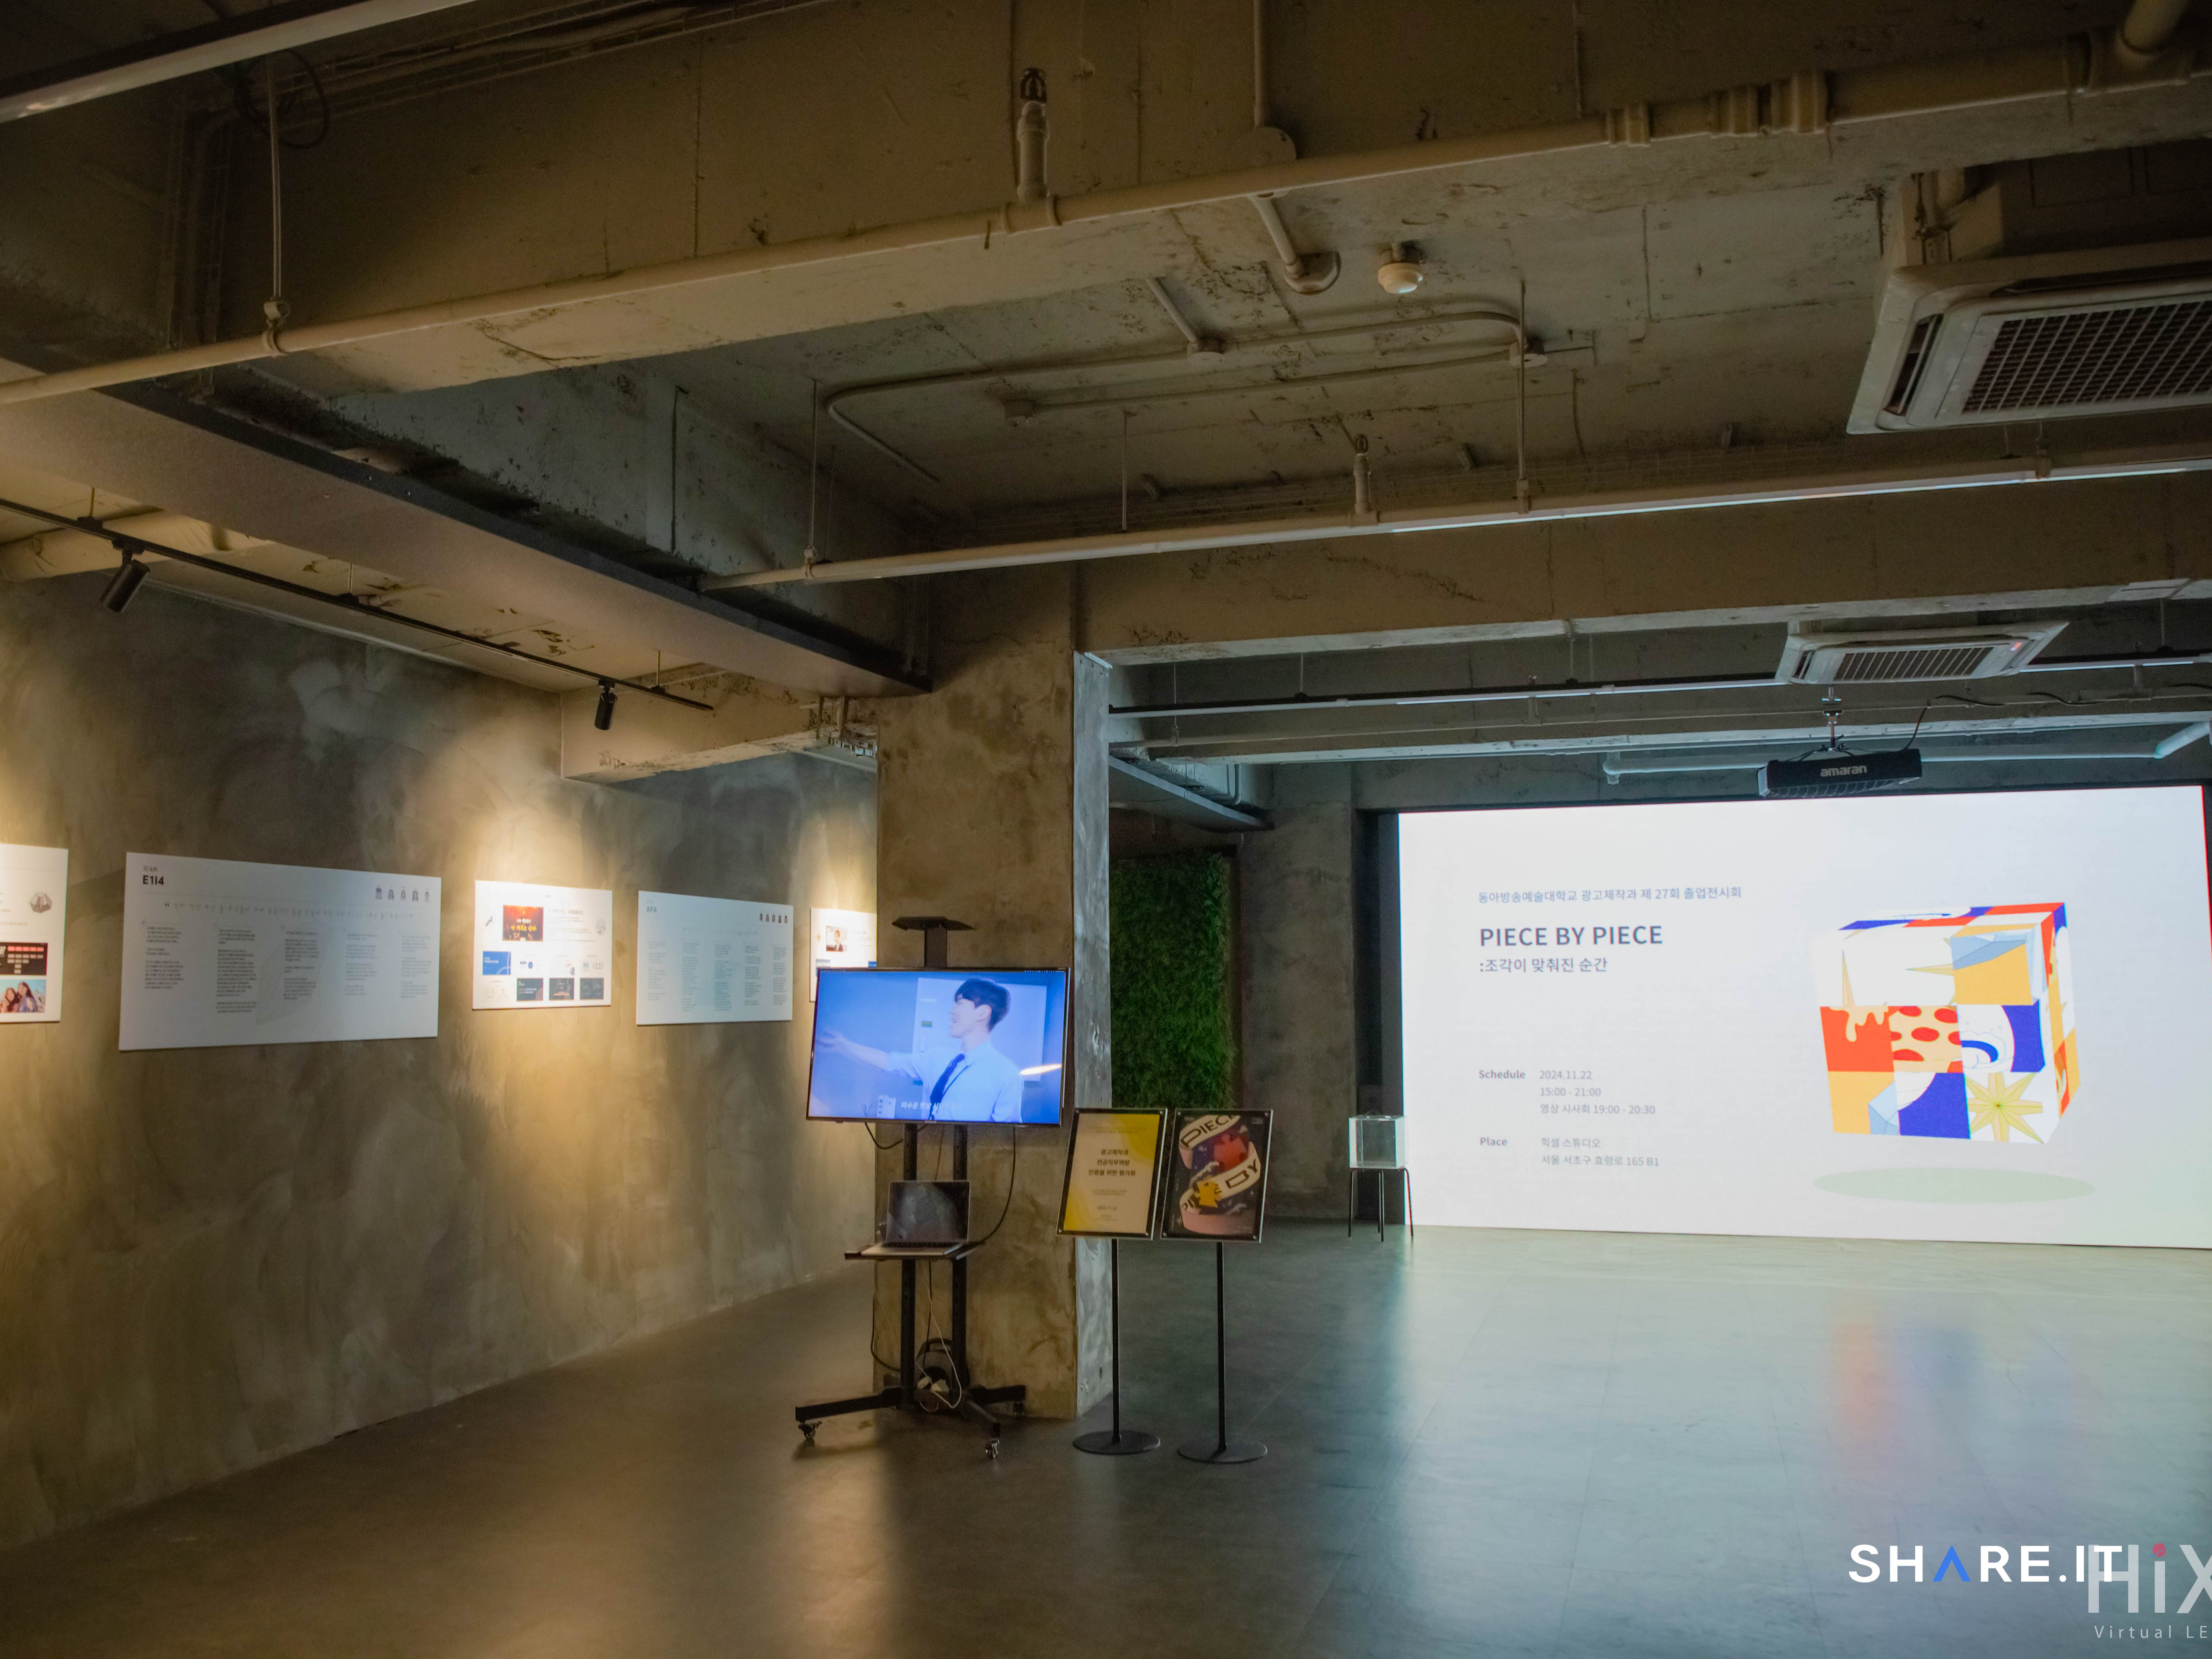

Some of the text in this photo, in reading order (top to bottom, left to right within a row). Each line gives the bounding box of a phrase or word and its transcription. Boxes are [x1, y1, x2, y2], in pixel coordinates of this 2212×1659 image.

[1820, 765, 1867, 777] amaran
[1478, 886, 1742, 904] 동아방송예술대학교 광고제작과 제 27회 졸업전시회
[1480, 926, 1663, 947] PIECE BY PIECE
[1480, 957, 1608, 973] :조각이 맞춰진 순간
[1478, 1070, 1526, 1079] Schedule
[1539, 1070, 1592, 1080] 2024.11.22
[1540, 1087, 1566, 1097] 15:00
[1574, 1087, 1601, 1097] 21:00
[1540, 1103, 1559, 1114] 영상
[1562, 1103, 1591, 1114] 시사회
[1594, 1105, 1620, 1114] 19:00
[1628, 1105, 1656, 1115] 20:30
[1180, 1115, 1234, 1147] PIEC
[1480, 1136, 1508, 1146] Place
[1562, 1138, 1601, 1149] 스튜디오
[1542, 1154, 1659, 1167] 서울 서초구 효령로 165 B1
[1225, 1159, 1258, 1189] BY
